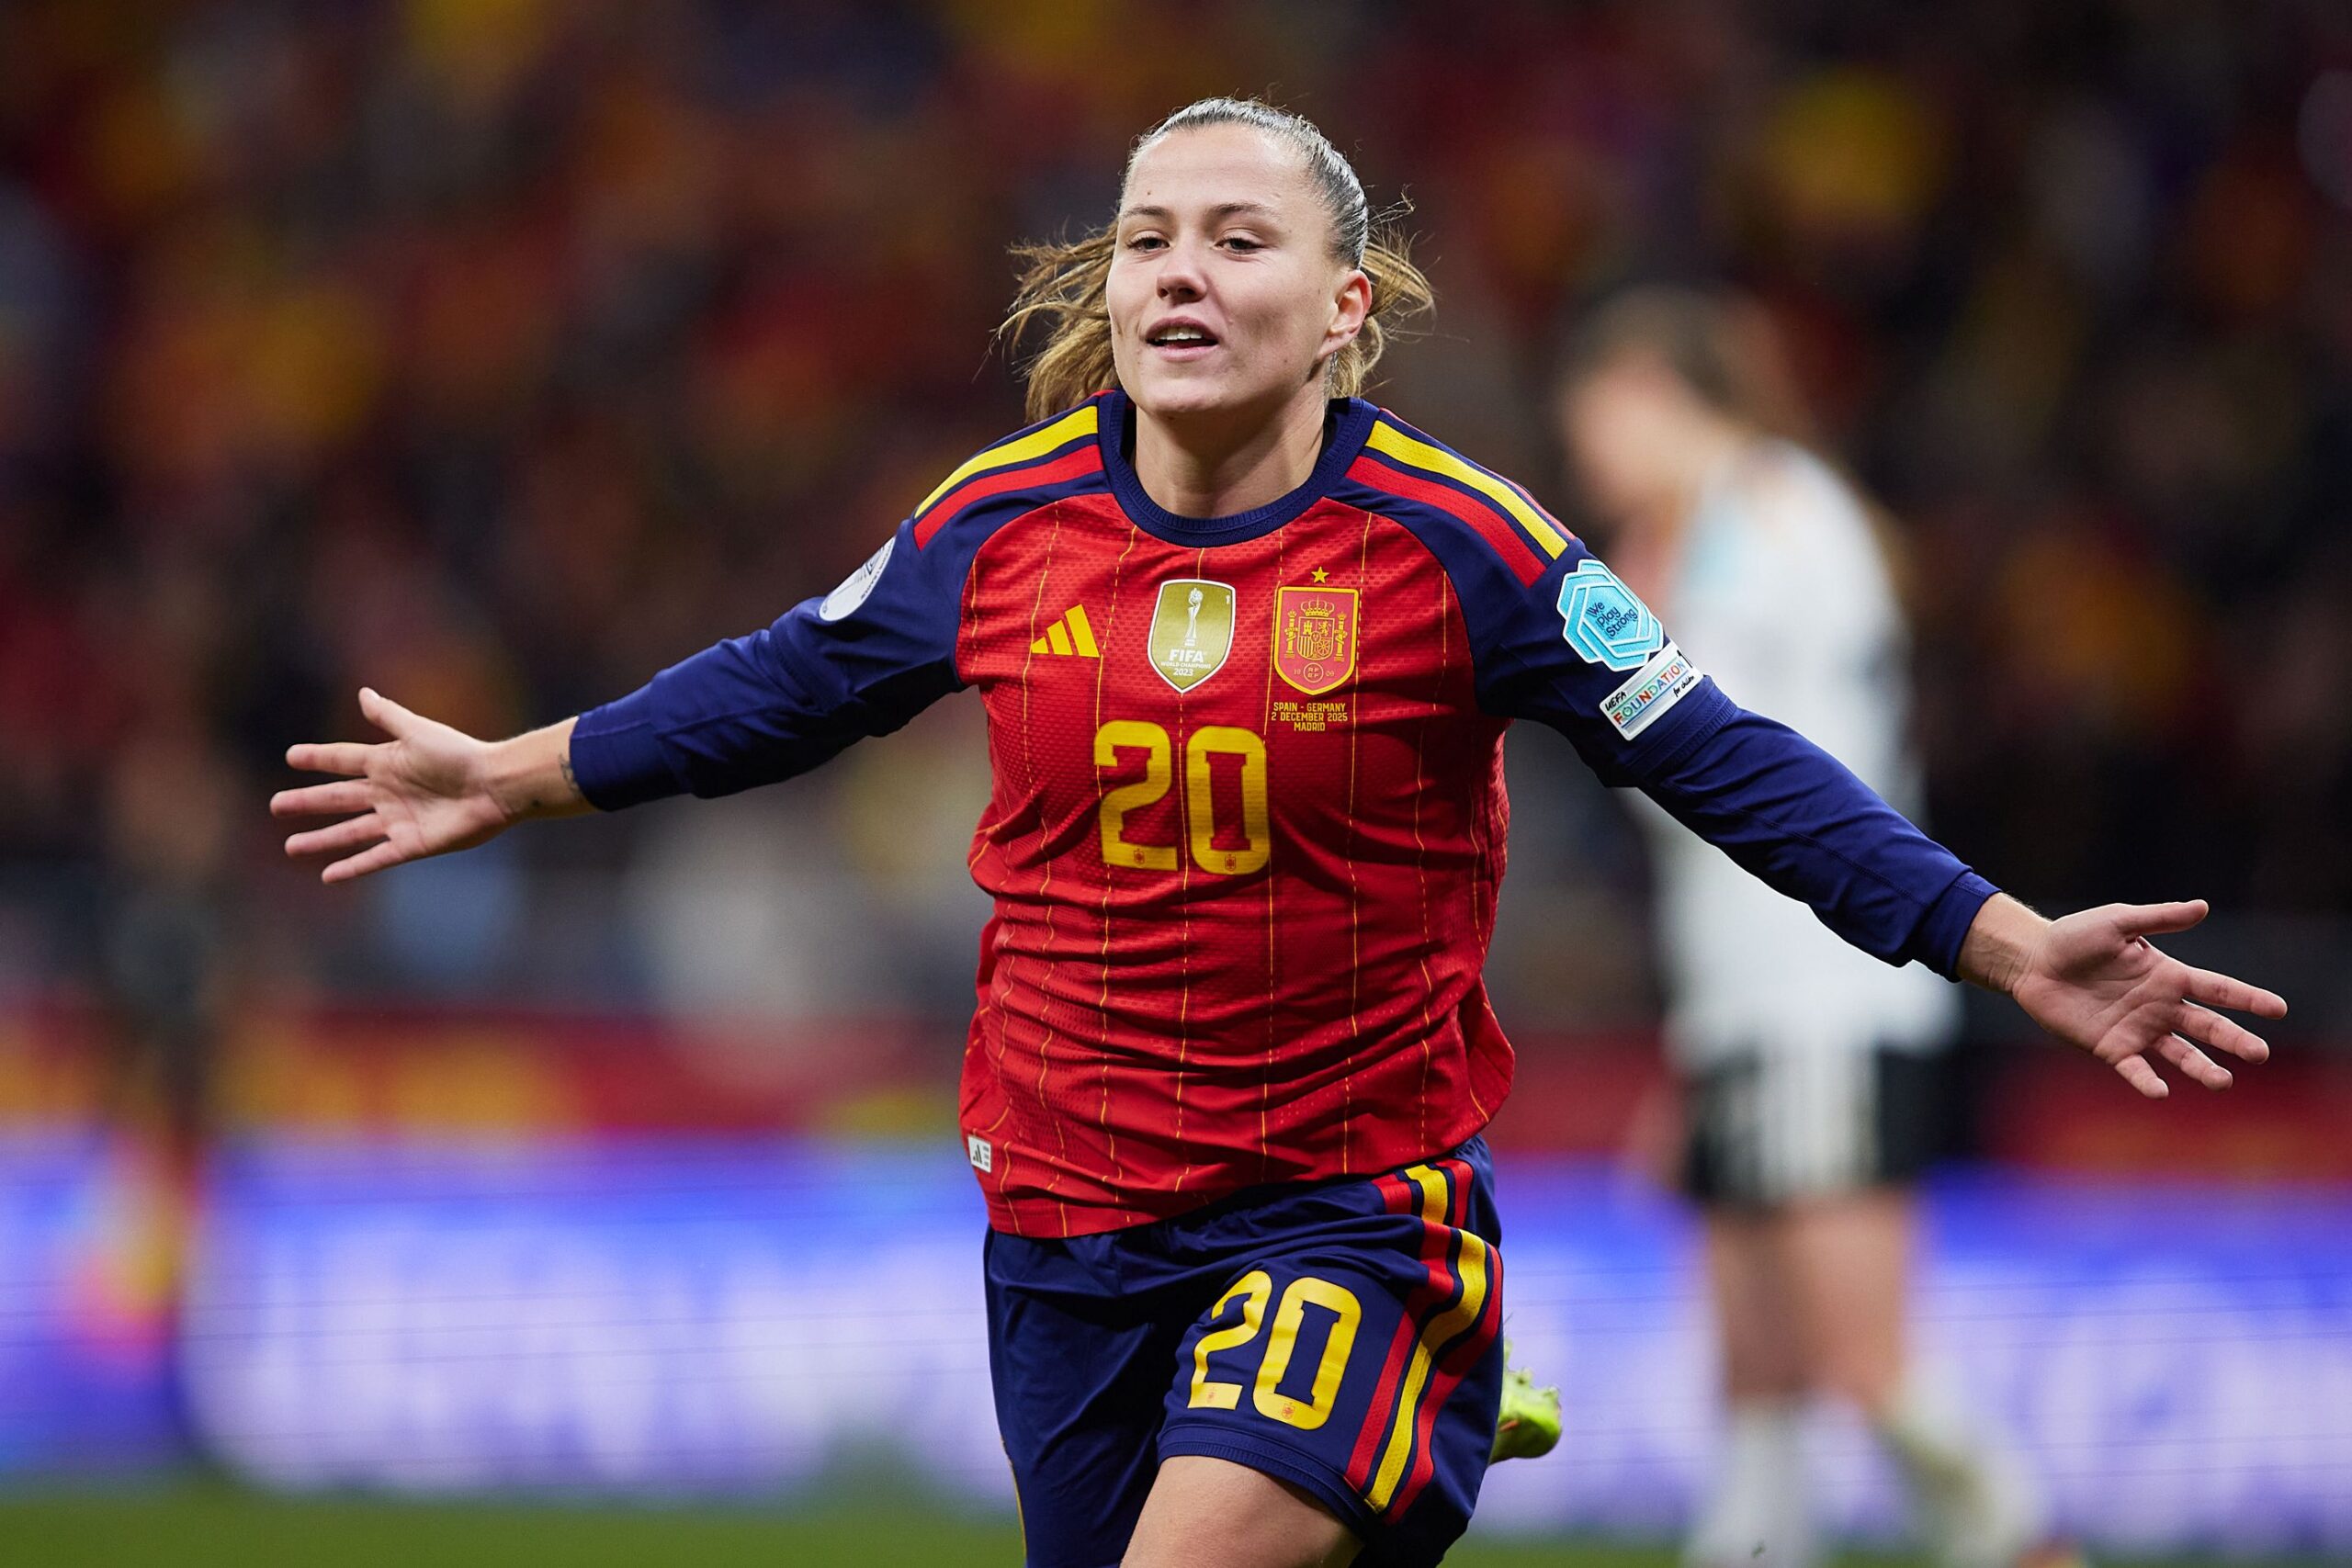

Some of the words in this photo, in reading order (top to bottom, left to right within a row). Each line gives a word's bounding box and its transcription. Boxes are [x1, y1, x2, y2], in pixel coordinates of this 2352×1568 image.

[1586, 602, 1605, 616] We
[1597, 606, 1621, 627] Play
[1606, 608, 1638, 637] Strong
[1169, 649, 1204, 663] FIFA
[1172, 667, 1193, 677] 2023
[1604, 690, 1627, 712] UEFA
[1612, 660, 1687, 726] FOUNDATION
[1273, 702, 1298, 712] SPAIN
[1306, 703, 1346, 713] GERMANY
[1271, 712, 1277, 721] 2
[1280, 712, 1324, 722] DECEMBER
[1327, 712, 1348, 722] 2025
[1294, 721, 1326, 732] MADRID
[1093, 719, 1271, 875] 20
[1187, 1269, 1362, 1431] 20
